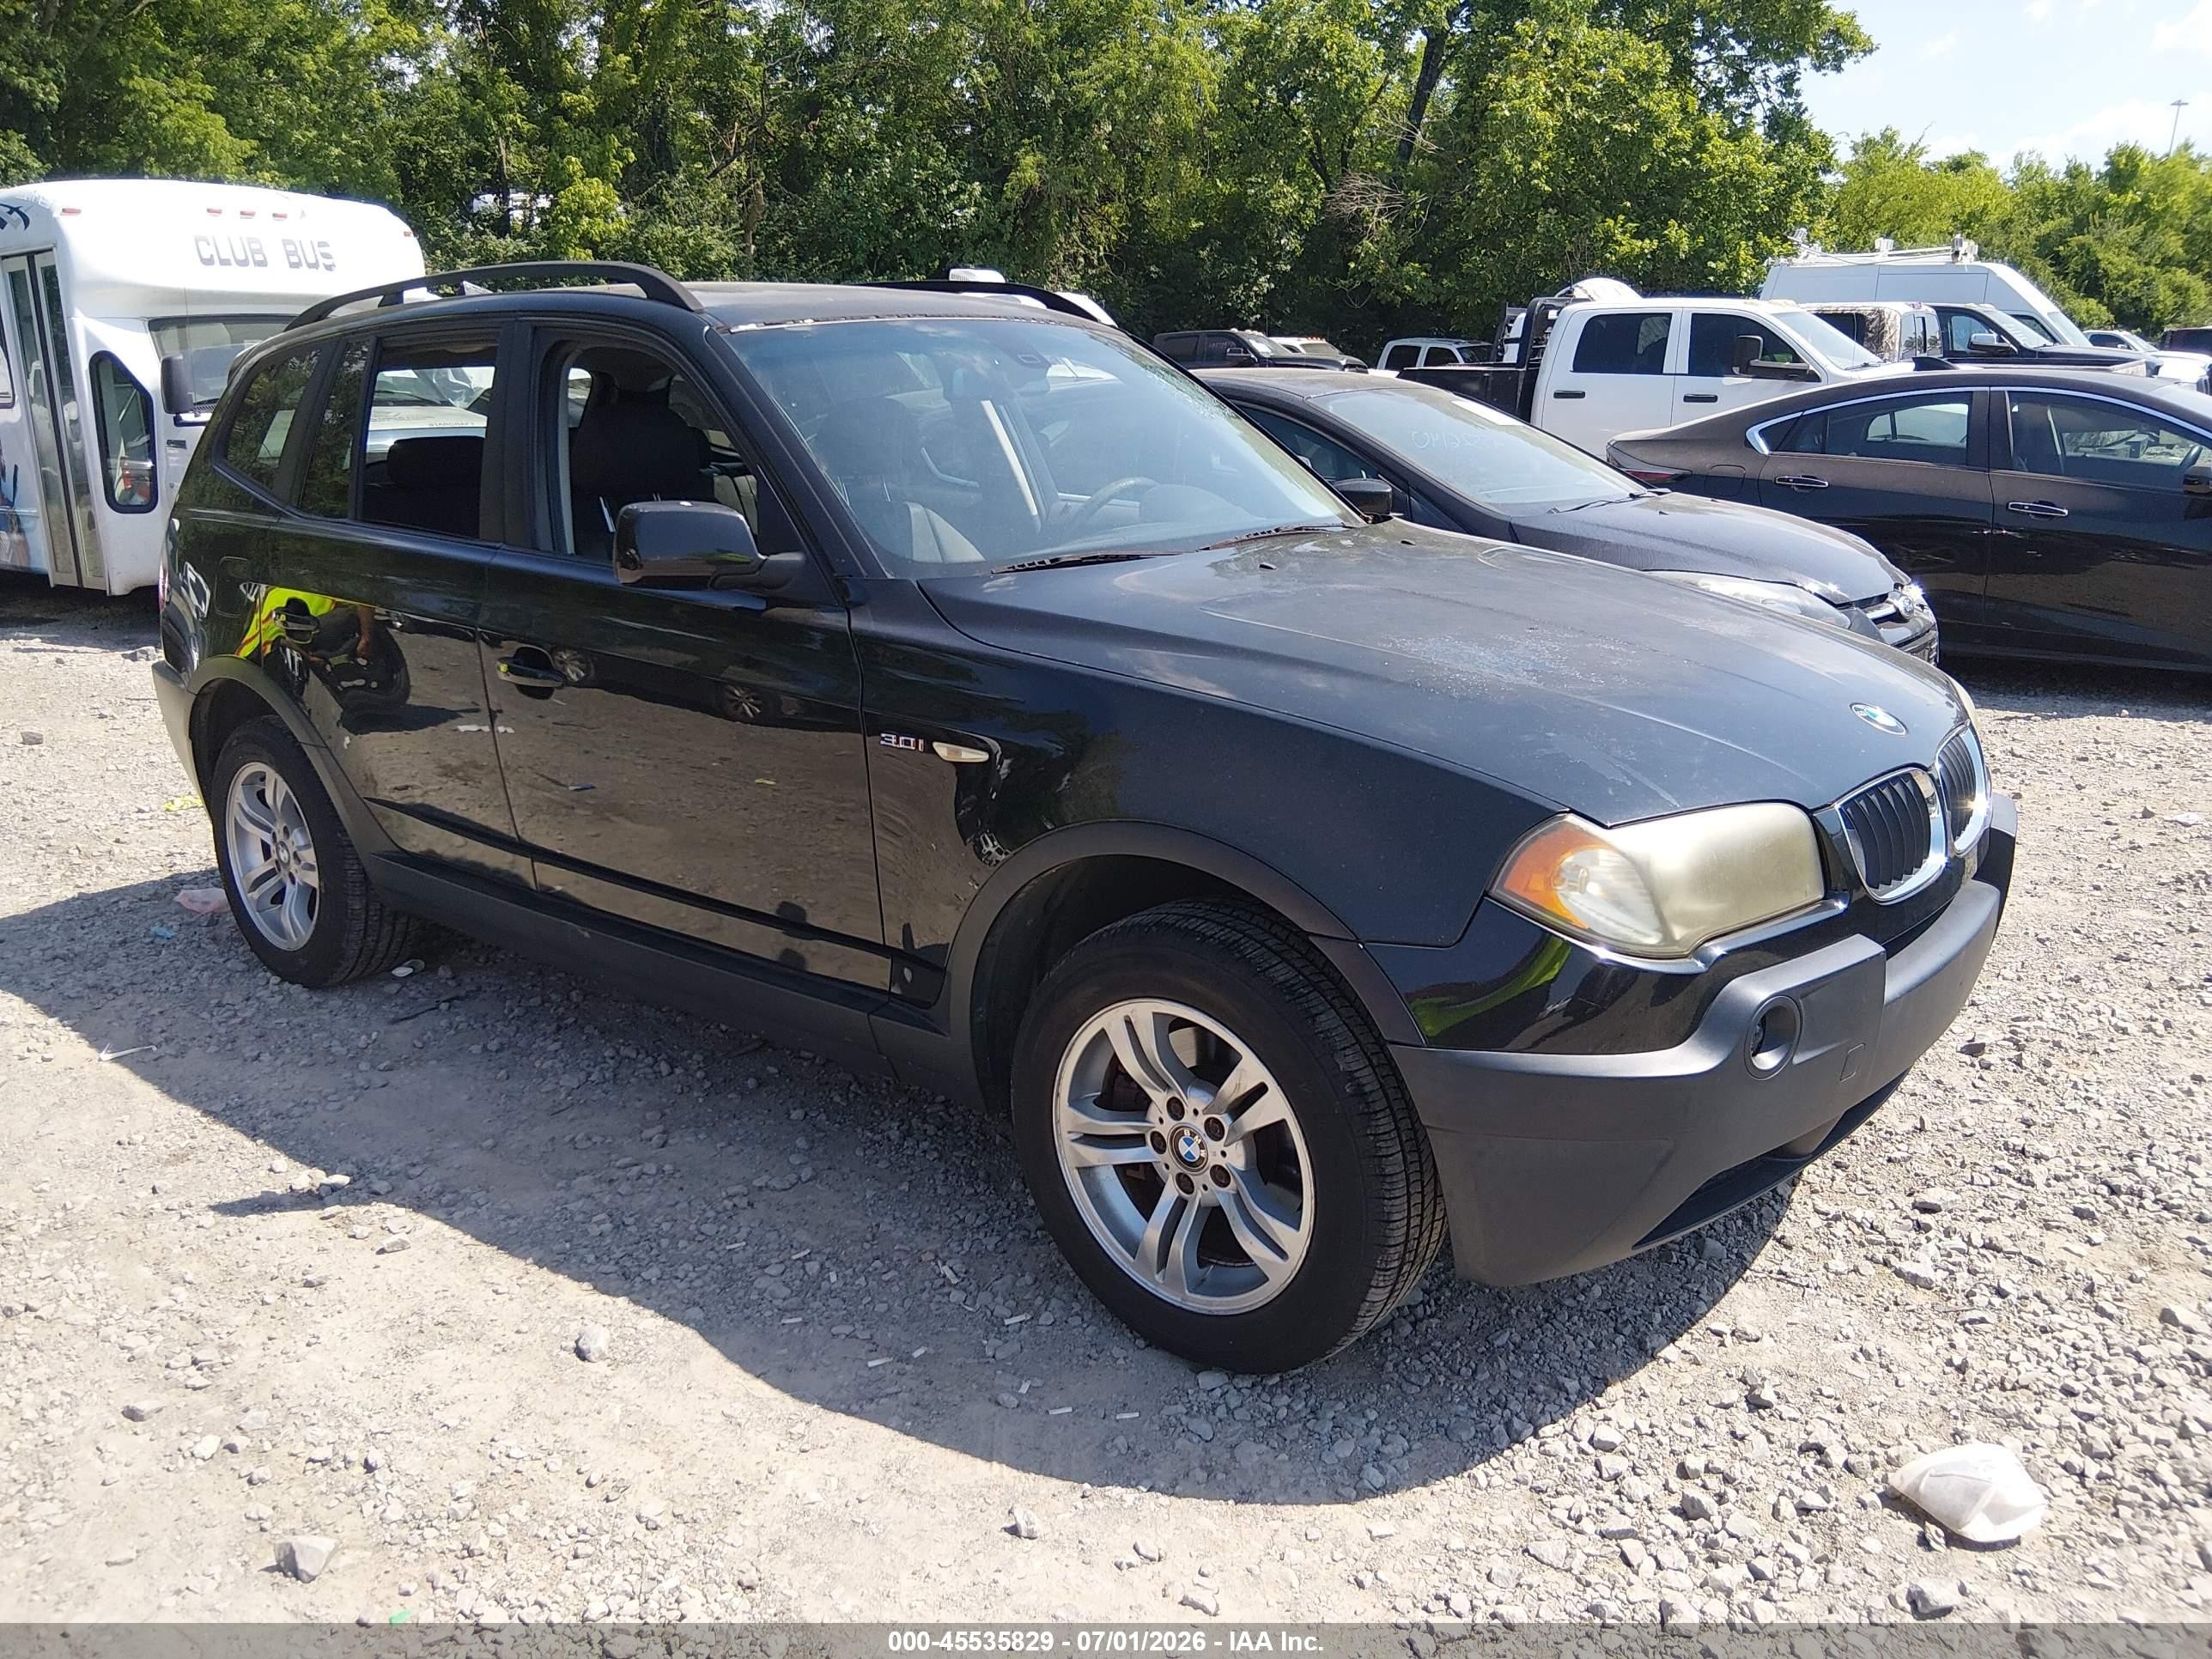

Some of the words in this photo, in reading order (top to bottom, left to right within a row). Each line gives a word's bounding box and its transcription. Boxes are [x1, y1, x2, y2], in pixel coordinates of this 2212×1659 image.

[194, 234, 268, 267] CLUB
[282, 239, 336, 271] BUS
[1183, 1129, 1206, 1158] BMW
